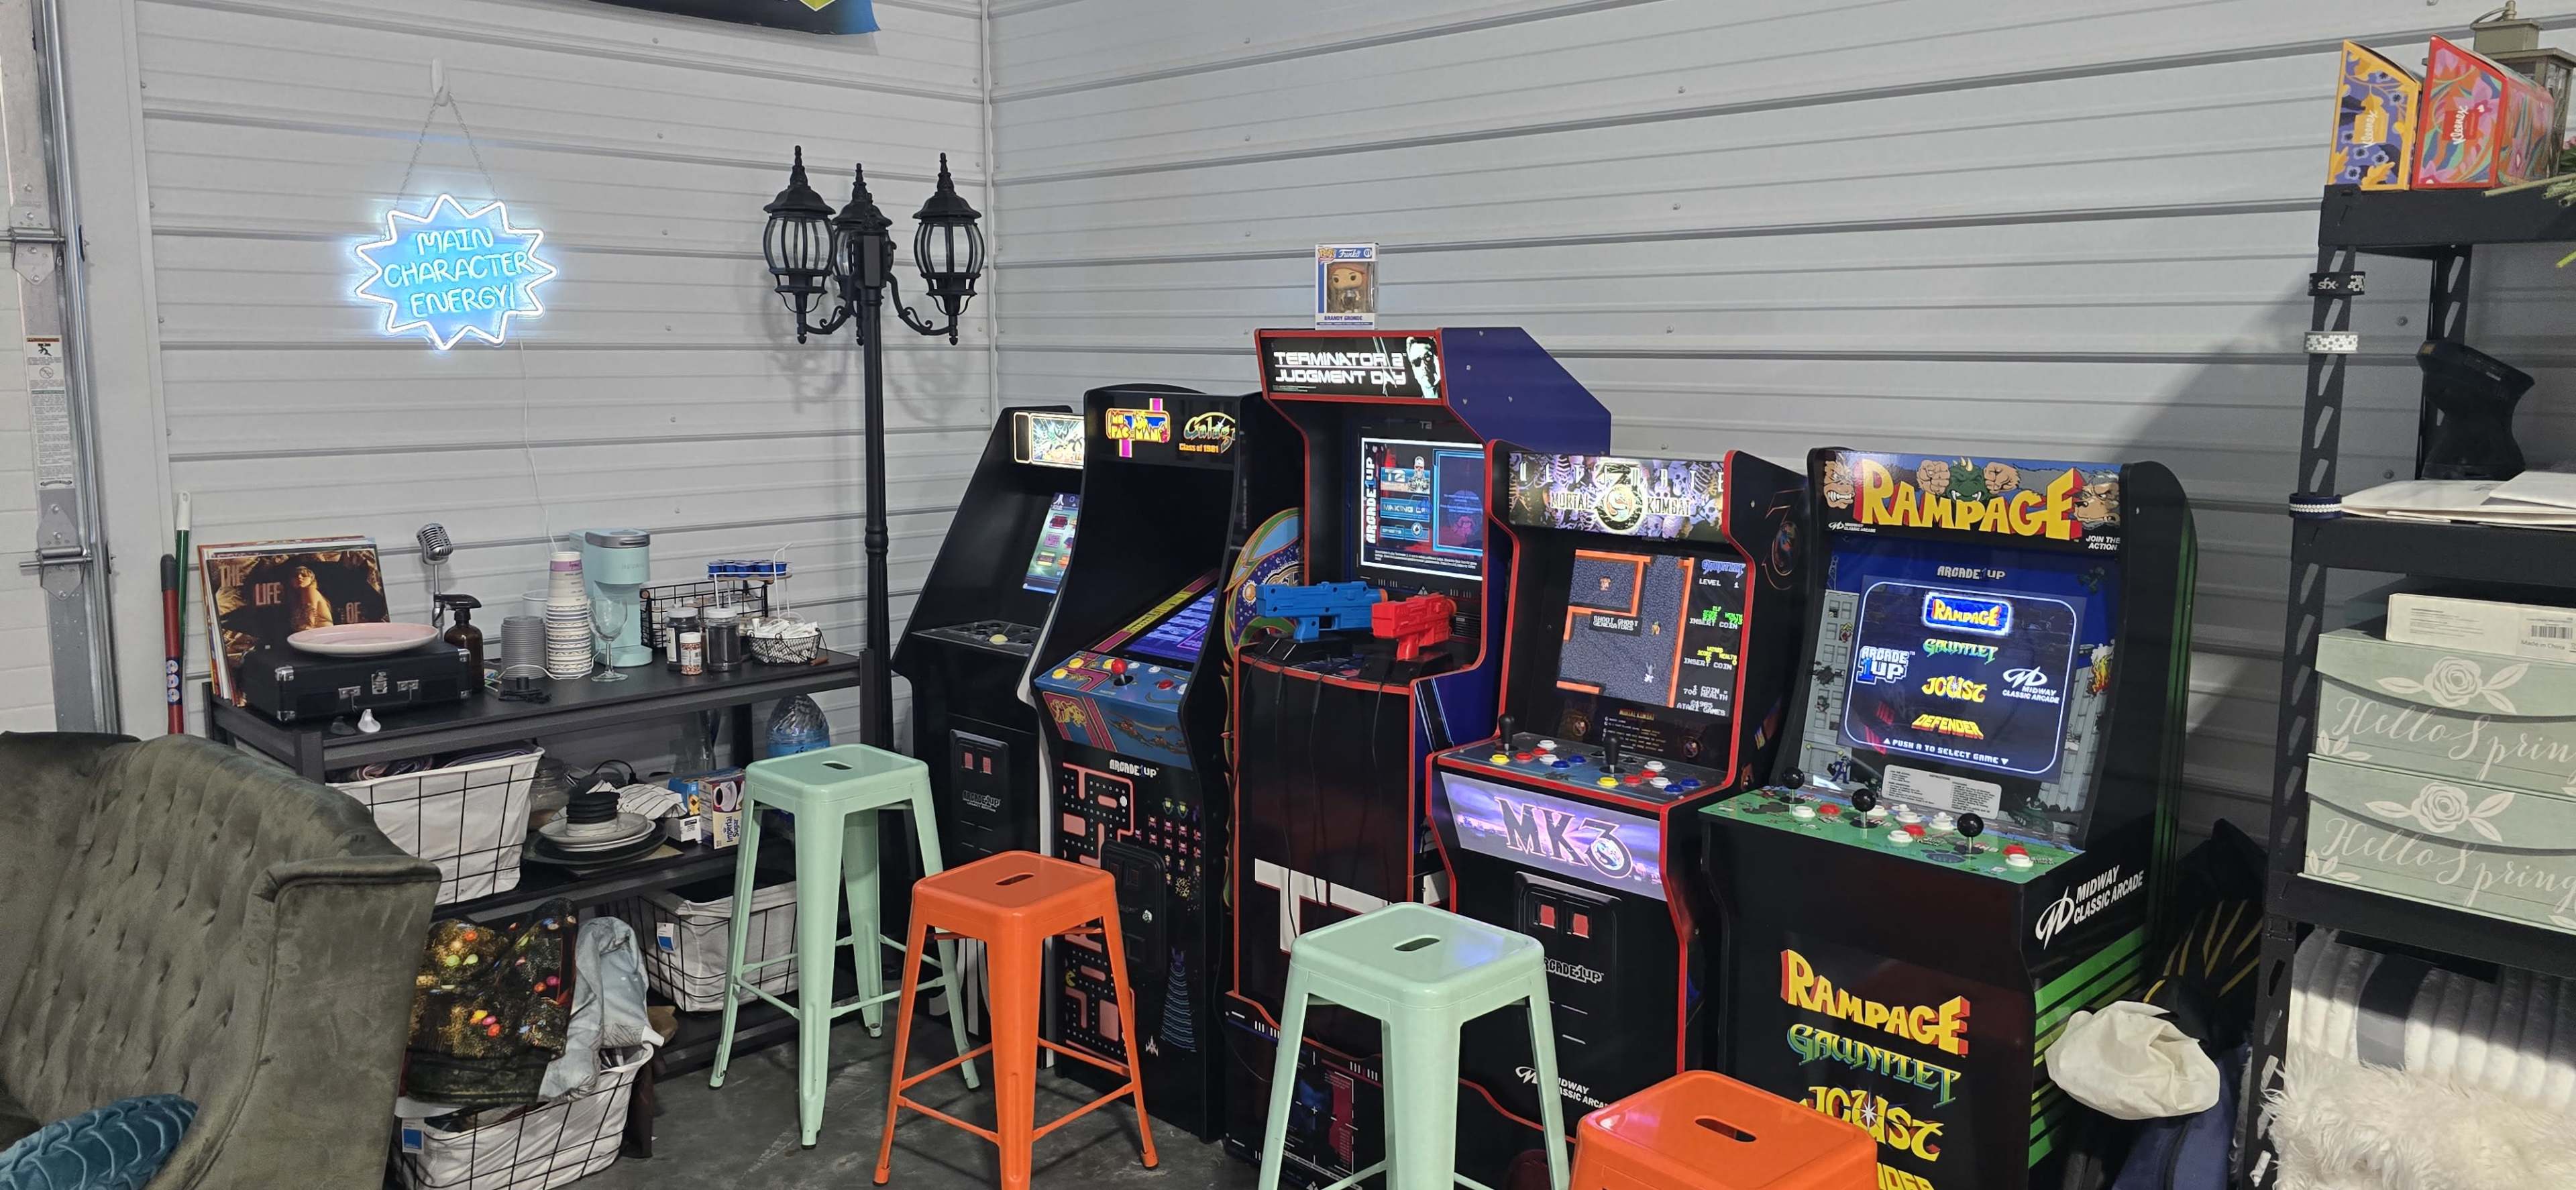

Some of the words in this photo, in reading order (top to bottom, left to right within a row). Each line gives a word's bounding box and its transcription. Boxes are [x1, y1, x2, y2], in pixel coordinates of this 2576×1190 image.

[2361, 110, 2378, 148] Kleenex
[2450, 105, 2469, 144] Kleenex
[416, 227, 494, 256] MAIN
[1338, 249, 1362, 258] Funko
[383, 252, 535, 288] CHARACTER
[410, 282, 516, 318] ENERGY!
[1273, 351, 1388, 367] TERMINATOR
[1390, 352, 1404, 368] 2
[1275, 370, 1366, 384] JUDGMENT
[1371, 370, 1407, 385] DAY
[1419, 421, 1432, 429] T2
[1179, 443, 1196, 452] Class
[1385, 468, 1406, 483] T2
[1383, 503, 1414, 513] MAKING
[1550, 491, 1589, 510] MORTAL
[1646, 496, 1691, 516] KOMBAT
[1852, 458, 2084, 541] RAMPAGE
[2106, 536, 2121, 544] THE
[219, 565, 246, 588] THE
[1699, 578, 1721, 586] LEVEL
[255, 582, 282, 606] LIFE
[345, 602, 362, 624] OF
[1931, 598, 2002, 627] RAMPAGE
[1719, 621, 1738, 630] COIN
[1860, 645, 1911, 665] ARCADE
[1922, 638, 1999, 665] GAUNTLET
[2547, 643, 2566, 651] China
[1683, 657, 1710, 667] INSERT
[1713, 661, 1733, 671] COIN
[1682, 688, 1698, 696] 700
[1700, 691, 1729, 702] HEALTH
[1701, 686, 1721, 694] COIN
[1921, 675, 1988, 704] JOUST
[2002, 689, 2031, 700] CLASSIC
[2031, 694, 2060, 704] ARCADE
[2021, 686, 2057, 696] MIDWAY
[1676, 702, 1700, 712] ATARI
[1702, 706, 1727, 717] GAMES
[2332, 696, 2447, 743] Hello
[1911, 713, 1984, 741] DEFENDER
[1892, 739, 1915, 749] PUSH
[1925, 744, 1936, 753] TO
[1937, 747, 1972, 759] SELECT
[1973, 753, 1999, 764] GAME
[726, 816, 734, 843] Imperial
[1493, 796, 1633, 879] MK3
[2320, 817, 2434, 866] Hello
[2076, 865, 2120, 904] MIDWAY
[2074, 889, 2110, 925] CLASSIC
[2110, 870, 2145, 904] ARCADE
[1544, 957, 1603, 984] RCADE1UP
[1780, 949, 1971, 1056] RAMPAGE
[1786, 1023, 1962, 1110] GAUNTLET
[1558, 1077, 1590, 1095] IDWAY
[1582, 1095, 1608, 1109] ARCA
[1799, 1085, 1945, 1162] JOUST
